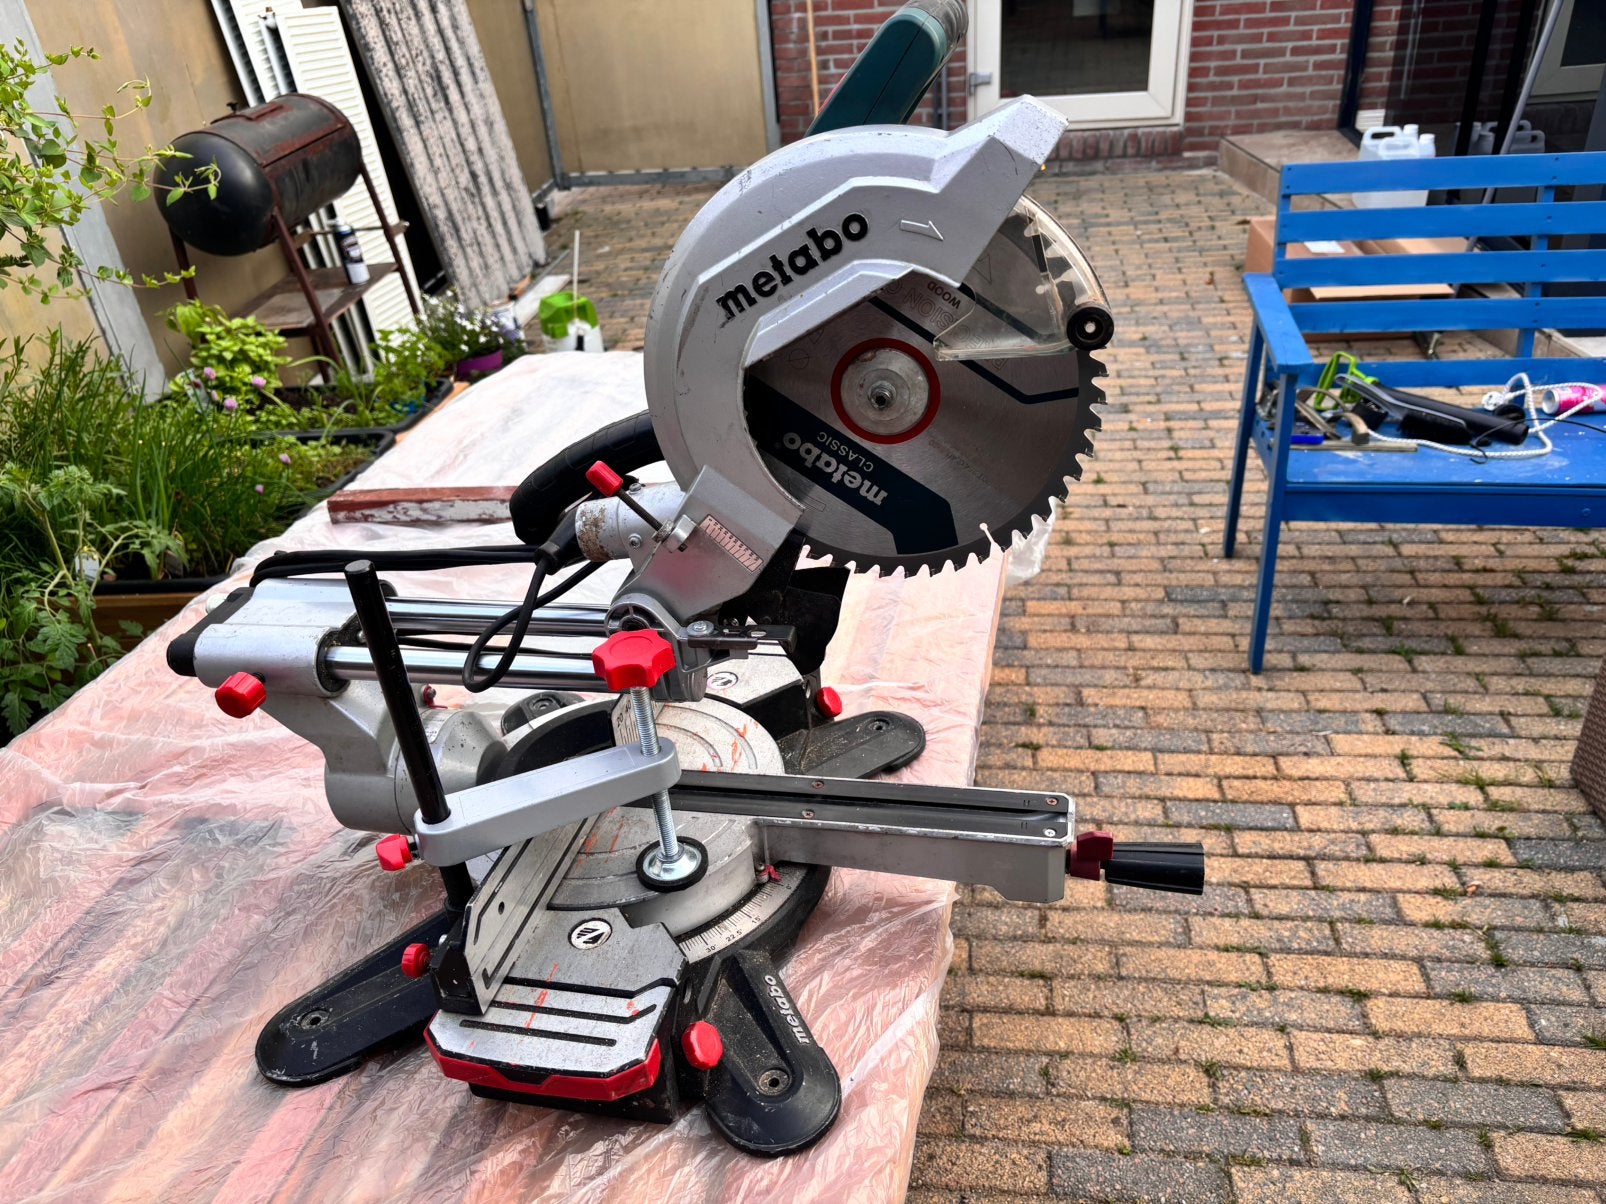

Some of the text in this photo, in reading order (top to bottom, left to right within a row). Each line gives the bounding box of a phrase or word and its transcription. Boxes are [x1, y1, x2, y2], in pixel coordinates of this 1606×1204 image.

[716, 213, 869, 321] metabo
[927, 281, 961, 309] WOOD
[783, 432, 888, 506] metabo
[817, 432, 873, 472] CLASSIC
[764, 974, 810, 1044] metabo
